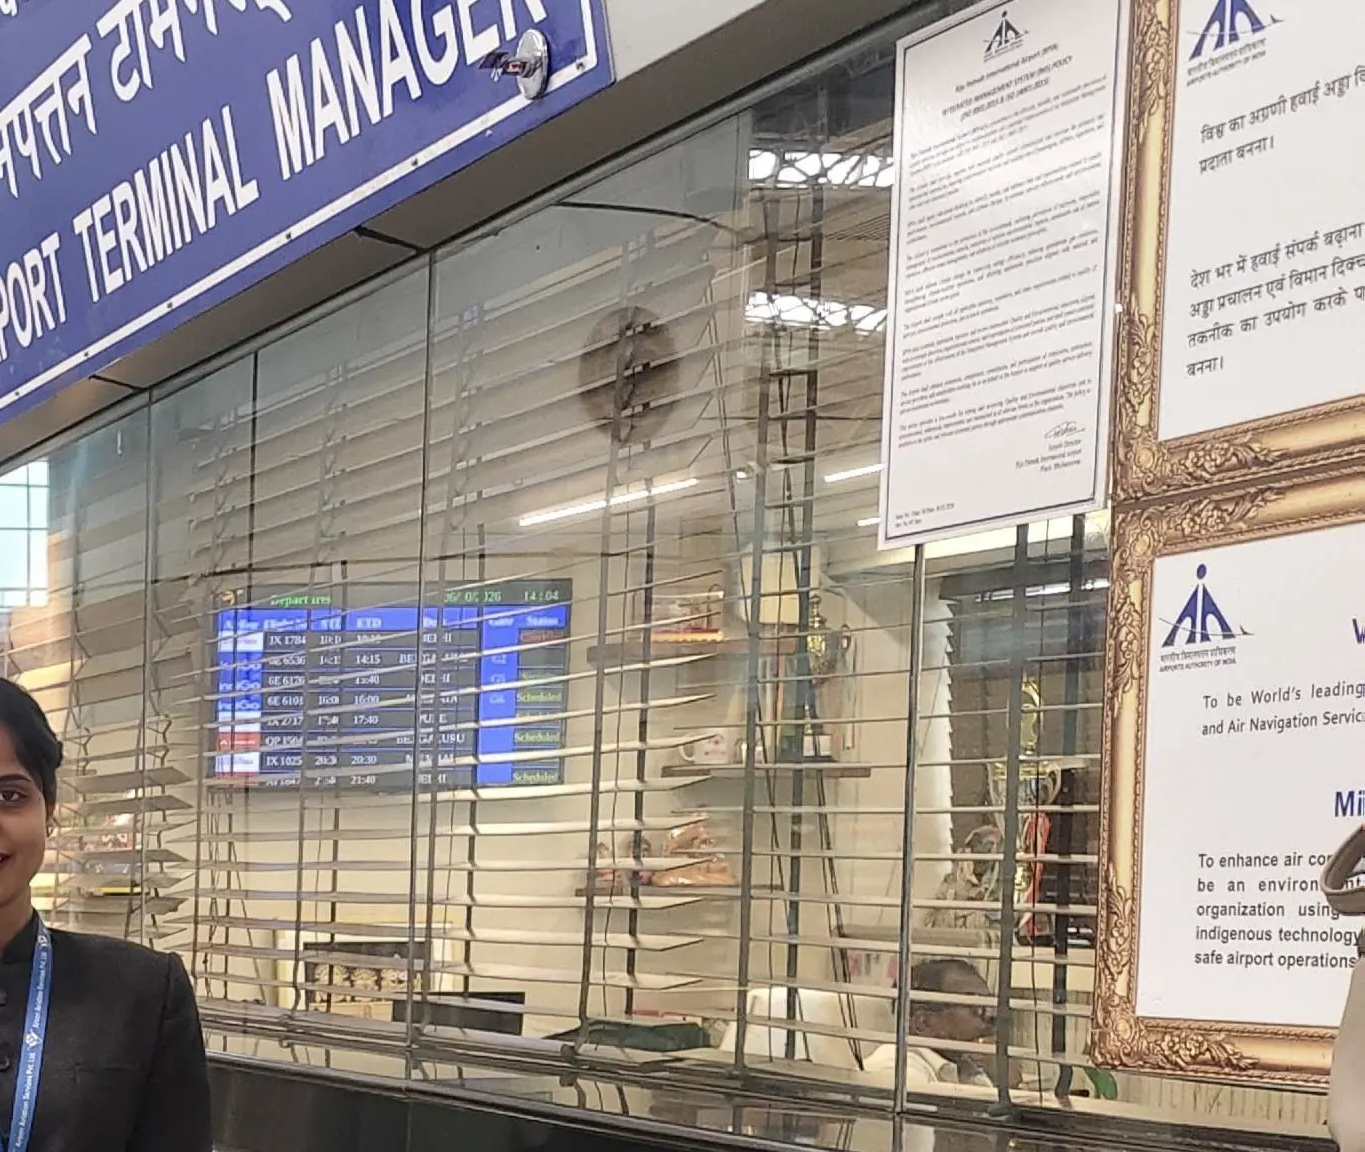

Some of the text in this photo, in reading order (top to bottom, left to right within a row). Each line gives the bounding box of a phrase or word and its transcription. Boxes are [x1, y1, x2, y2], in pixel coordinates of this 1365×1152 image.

[1229, 114, 1246, 131] का
[1249, 95, 1287, 125] अग्रणी
[1290, 81, 1320, 113] हवाई
[1199, 148, 1233, 175] प्रदाता
[73, 105, 258, 303] TERMINAL
[1190, 222, 1365, 290] देश भर में हवाई संपर्क बढ़ाना
[1217, 283, 1263, 312] प्रचालन
[1266, 273, 1286, 300] एवं
[1289, 264, 1329, 290] विमान
[1187, 321, 1235, 349] तकनीक
[1239, 316, 1259, 333] का
[1263, 301, 1308, 327] उपयोग
[1313, 286, 1349, 312] करके
[1187, 356, 1225, 378] बनना।
[357, 654, 382, 665] 14:15
[1159, 657, 1237, 673] AIRPORTS AUTHORITY OF INDIA
[354, 695, 379, 705] 16:00
[1203, 695, 1218, 709] To
[1226, 693, 1243, 707] be
[353, 715, 378, 725] 17:40
[1202, 720, 1224, 735] and
[1228, 719, 1246, 734] Air
[1249, 712, 1318, 734] Navigation
[351, 755, 377, 764] 20:30
[1198, 852, 1304, 868] To enhance air
[1197, 878, 1214, 893] be
[1227, 879, 1245, 892] an
[1196, 902, 1340, 921] organization using
[1195, 926, 1359, 946] indigenous technology
[1194, 950, 1357, 970] safe airport operations
